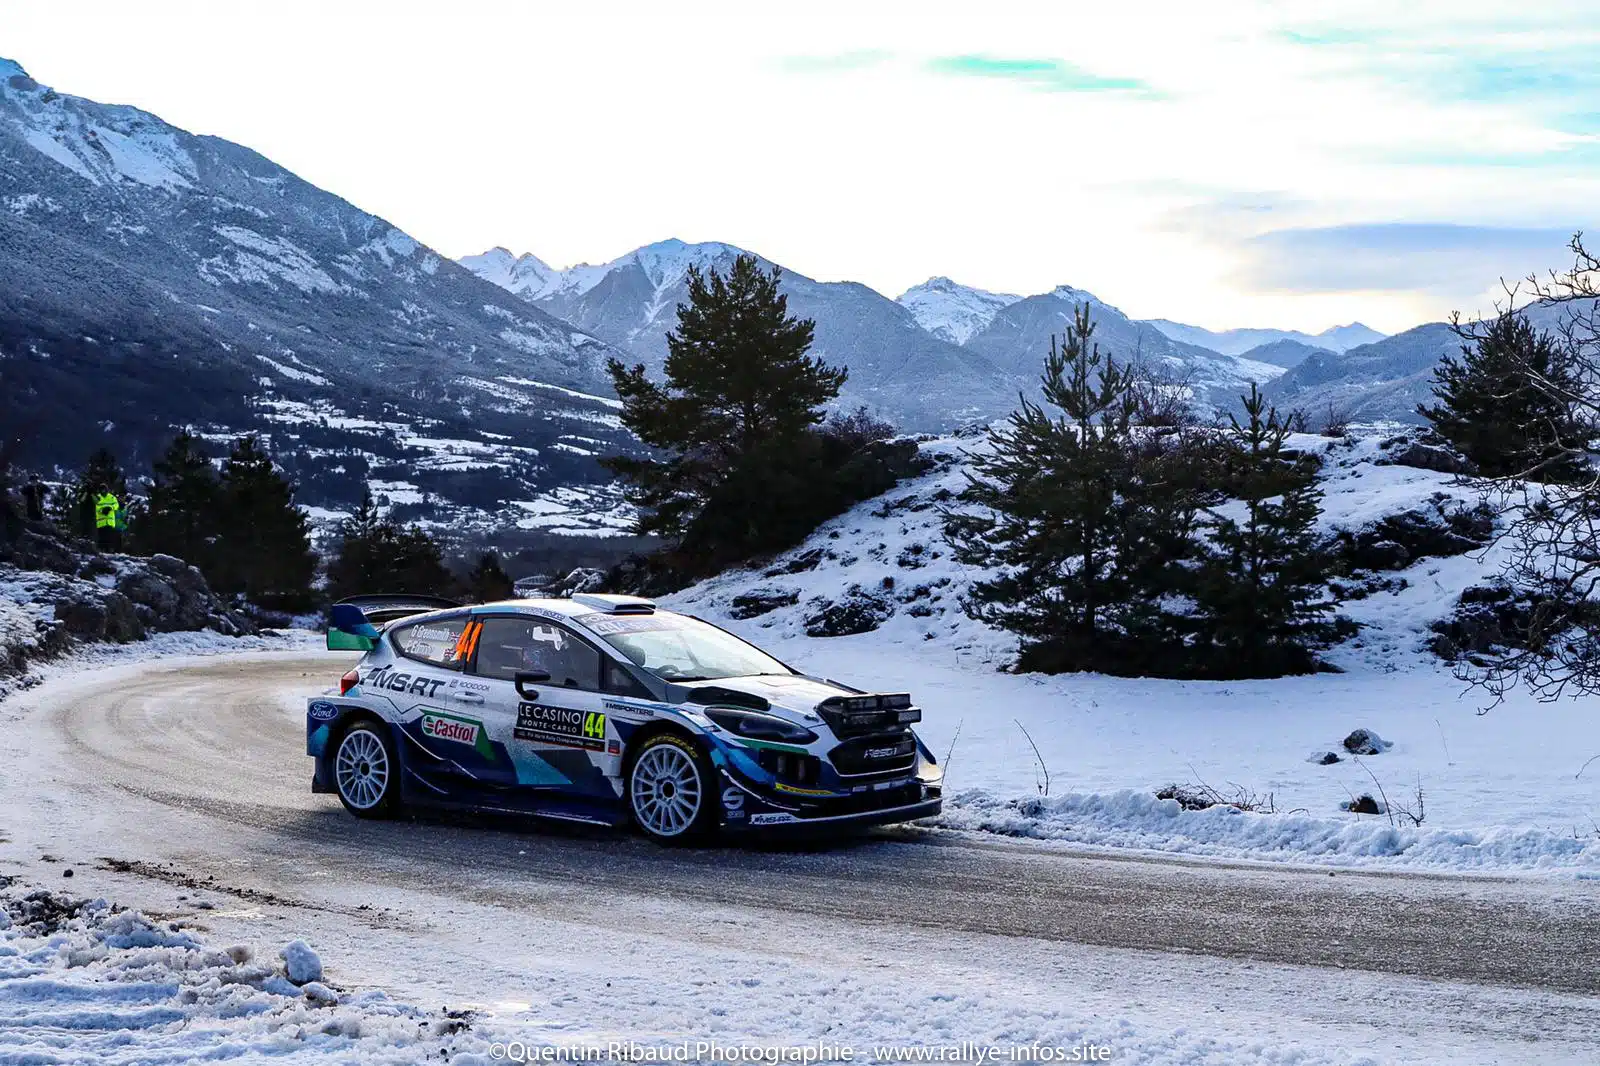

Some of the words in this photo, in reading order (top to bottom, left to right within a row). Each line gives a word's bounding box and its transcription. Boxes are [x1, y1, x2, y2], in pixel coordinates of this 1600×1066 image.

[456, 621, 484, 664] 44
[311, 704, 333, 717] Ford
[520, 705, 532, 717] LE
[533, 707, 581, 725] CASINO
[434, 719, 475, 742] Castrol
[522, 719, 578, 733] MONTE-CARLO
[584, 712, 606, 739] 44
